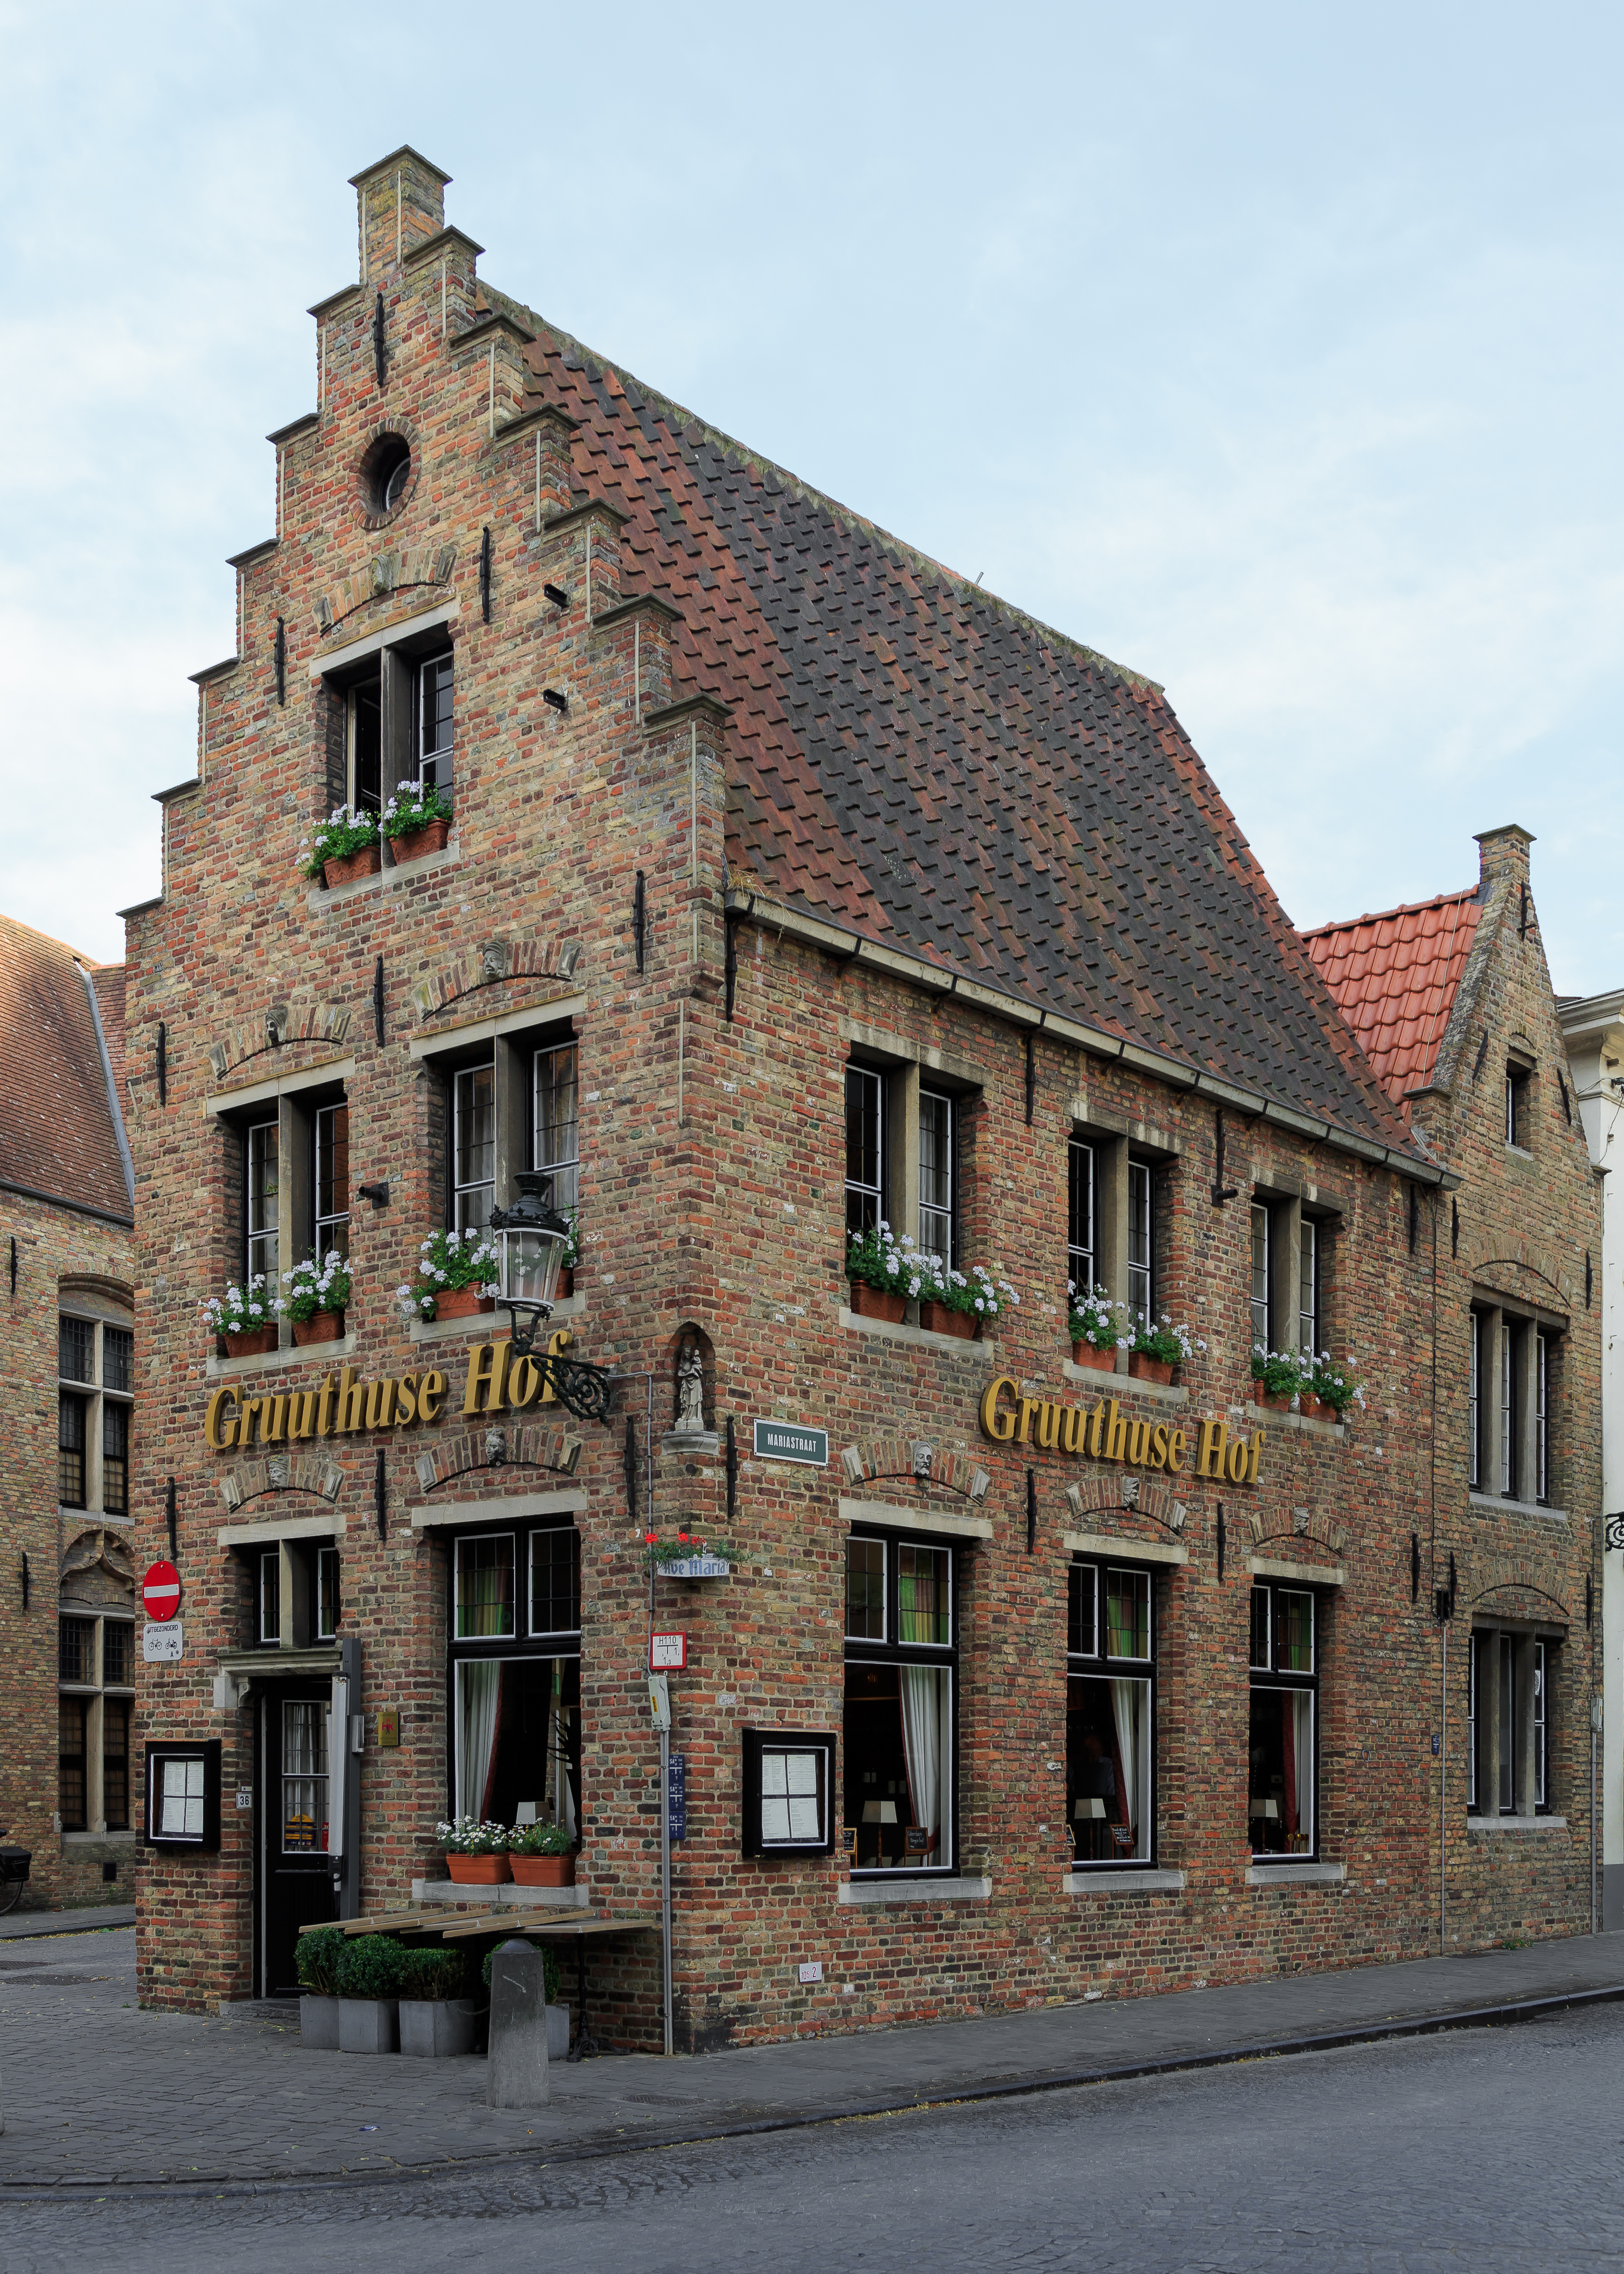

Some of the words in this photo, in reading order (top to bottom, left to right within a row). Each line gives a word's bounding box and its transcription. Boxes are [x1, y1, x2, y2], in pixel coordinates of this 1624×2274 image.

[204, 1367, 447, 1450] Gruuthuse
[459, 1330, 572, 1415] Hof
[980, 1376, 1187, 1472] Gruuthuse
[1194, 1419, 1266, 1484] Hof
[767, 1433, 817, 1453] MARIASTRAAT
[664, 1561, 685, 1575] Ave
[689, 1559, 725, 1575] Maria
[147, 1624, 178, 1634] UITGEZONDERD
[659, 1636, 677, 1645] H110
[240, 1795, 249, 1806] 36
[801, 1970, 810, 1979] 105
